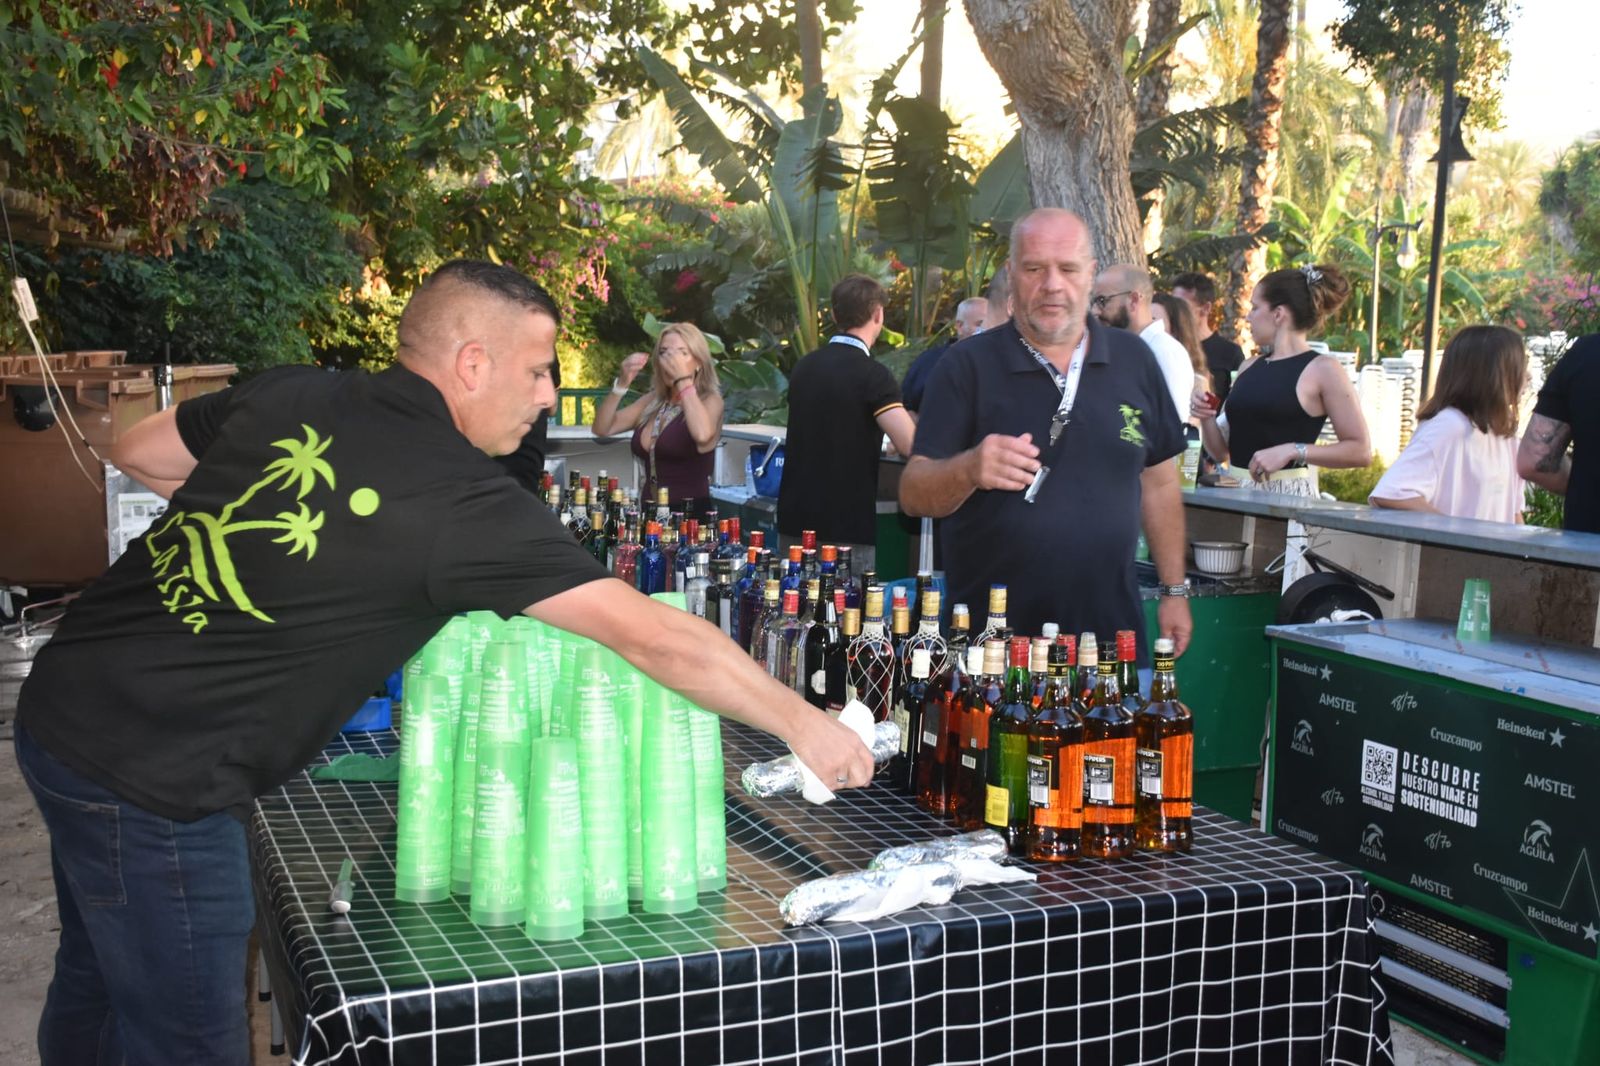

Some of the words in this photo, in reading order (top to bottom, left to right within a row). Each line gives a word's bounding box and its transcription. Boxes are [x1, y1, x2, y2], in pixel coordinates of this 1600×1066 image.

[1282, 657, 1318, 678] Heineken
[1318, 692, 1358, 714] AMSTEL
[1430, 726, 1482, 752] Cruzcampo
[1496, 717, 1547, 741] Heineken
[1402, 751, 1481, 793] DESCUBRE
[1523, 772, 1576, 799] AMSTEL
[1401, 771, 1439, 797] NUESTRO
[1440, 783, 1466, 806] VIAJE
[1466, 792, 1479, 810] EN
[1400, 787, 1478, 829] SOSTENIBILIDAD
[1277, 818, 1319, 844] Cruzcampo
[1409, 873, 1454, 900] AMSTEL
[1473, 862, 1529, 893] Cruzcampo
[1527, 905, 1578, 934] Heineken
